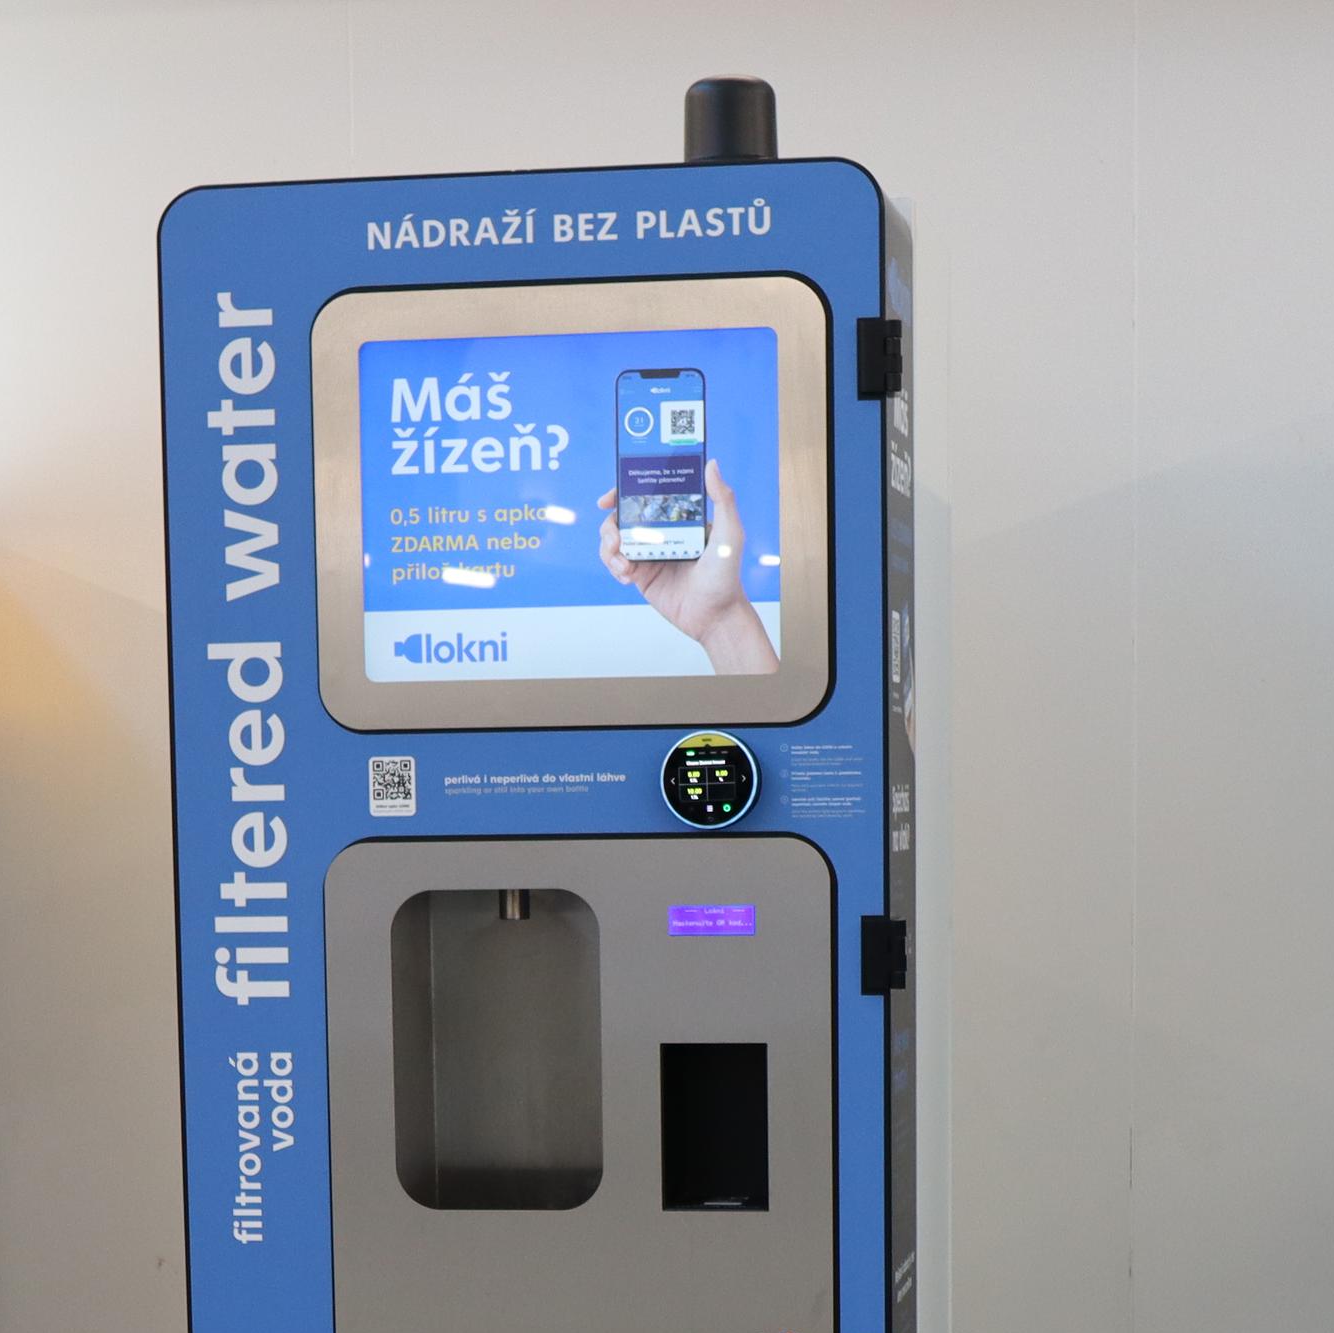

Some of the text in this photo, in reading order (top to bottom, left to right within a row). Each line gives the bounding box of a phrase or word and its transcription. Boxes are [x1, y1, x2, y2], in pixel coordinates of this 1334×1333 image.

[366, 197, 772, 252] NÁDRAŽÍ BEZ PLASTŮ
[391, 371, 513, 423] Máš
[391, 422, 570, 475] žízeň?
[390, 506, 487, 527] 0,5 litru s
[391, 531, 541, 553] ZDARMA nebo
[208, 292, 290, 1006] filtered water
[425, 631, 508, 664] lokni
[444, 775, 481, 786] perlivá
[490, 774, 540, 786] neperlivá
[542, 773, 556, 783] do
[596, 772, 627, 782] láhve
[262, 1051, 295, 1151] voda
[227, 1051, 263, 1245] filtrovaná
